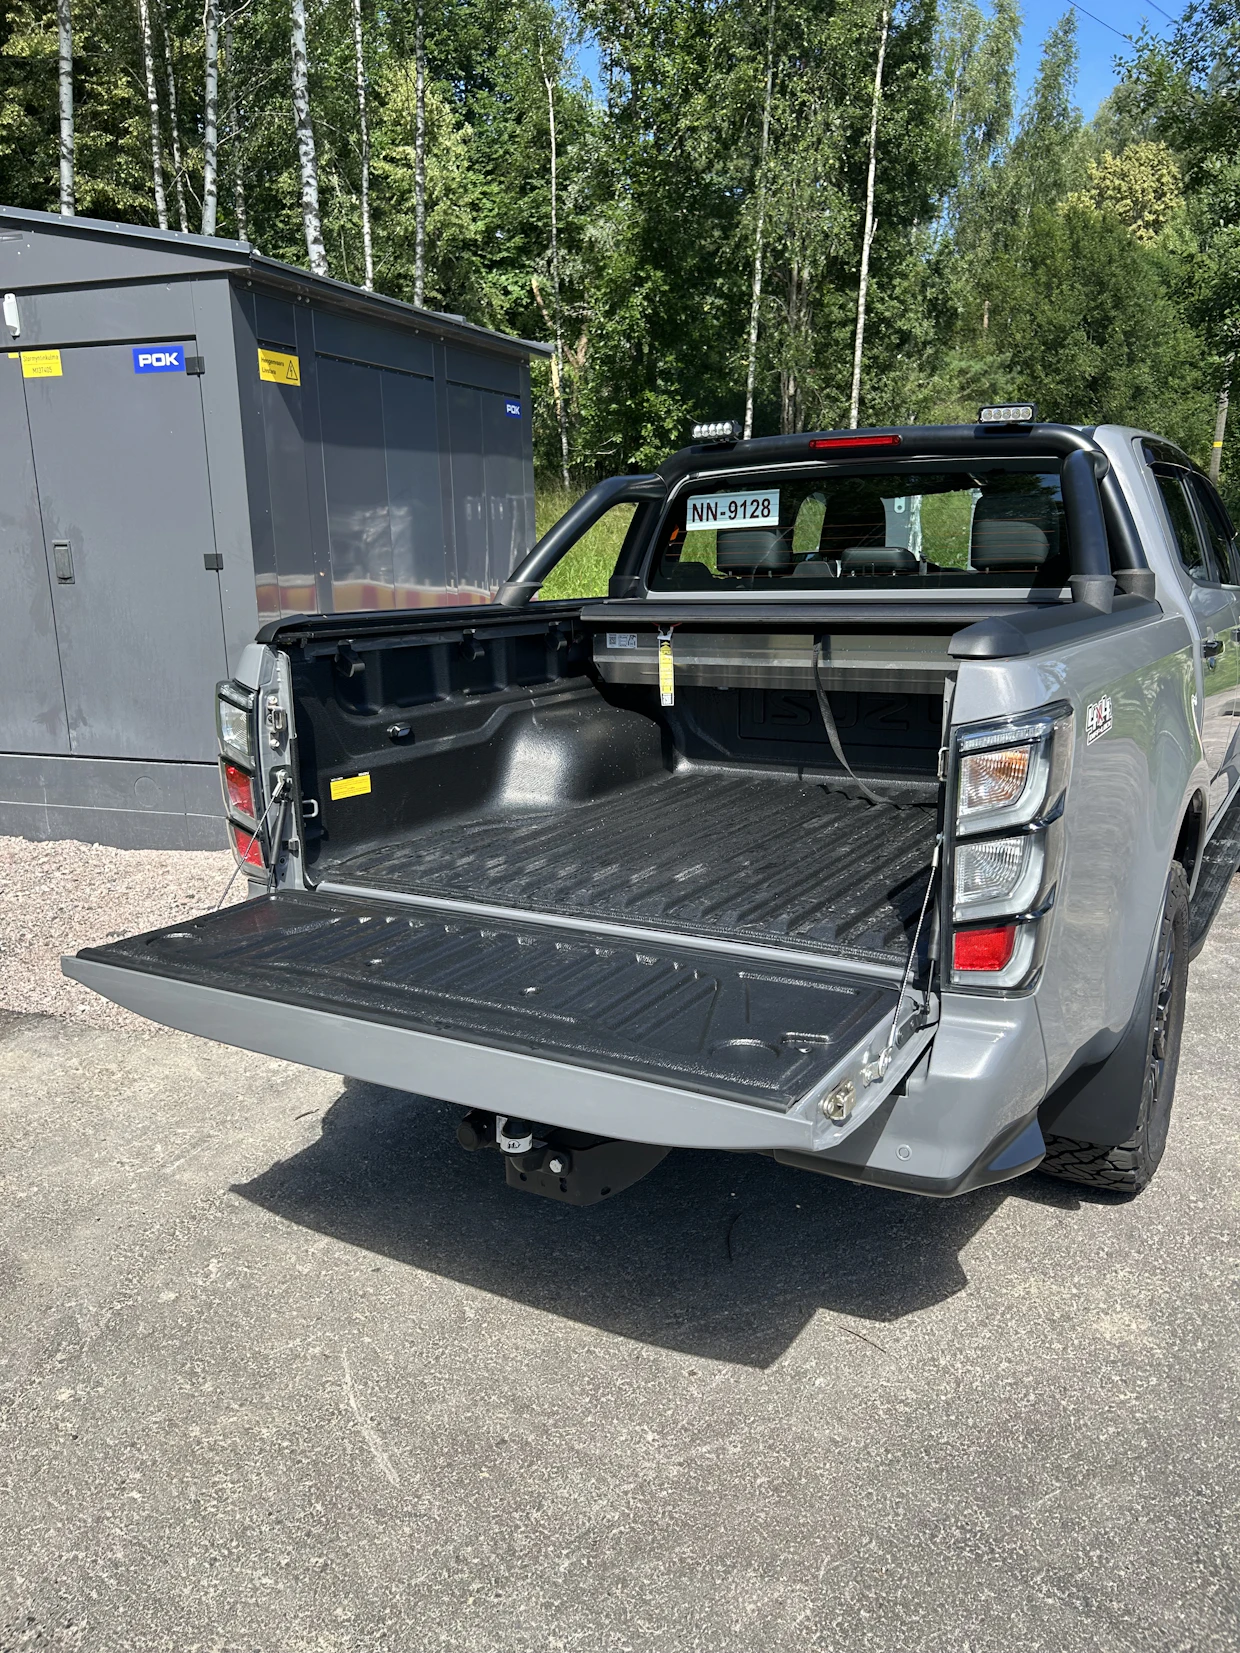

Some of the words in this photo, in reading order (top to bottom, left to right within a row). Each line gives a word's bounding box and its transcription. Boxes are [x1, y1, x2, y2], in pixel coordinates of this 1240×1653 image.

[138, 352, 179, 368] POK
[506, 404, 520, 415] POK
[692, 498, 771, 522] NN-9128
